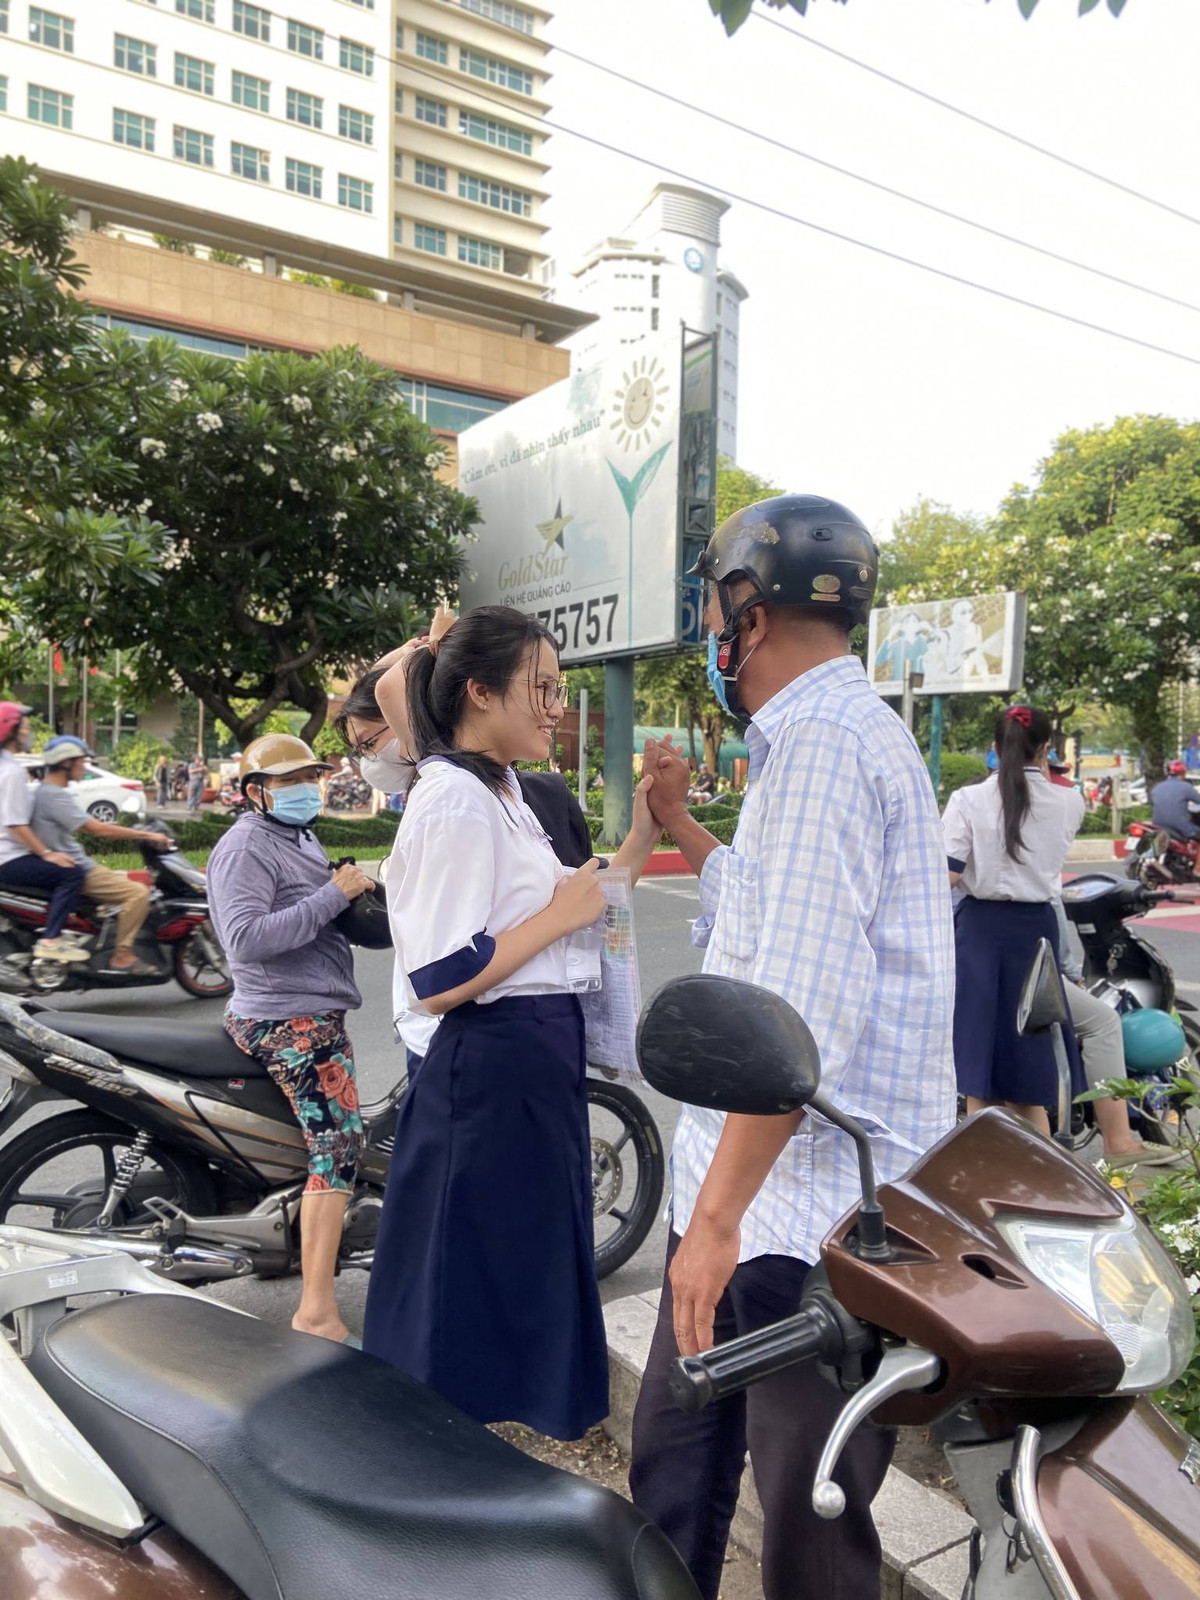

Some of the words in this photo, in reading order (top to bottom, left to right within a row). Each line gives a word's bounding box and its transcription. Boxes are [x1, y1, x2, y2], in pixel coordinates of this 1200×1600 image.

[497, 551, 569, 591] GoldStar
[554, 580, 571, 596] CÁO
[526, 593, 619, 652] 75757
